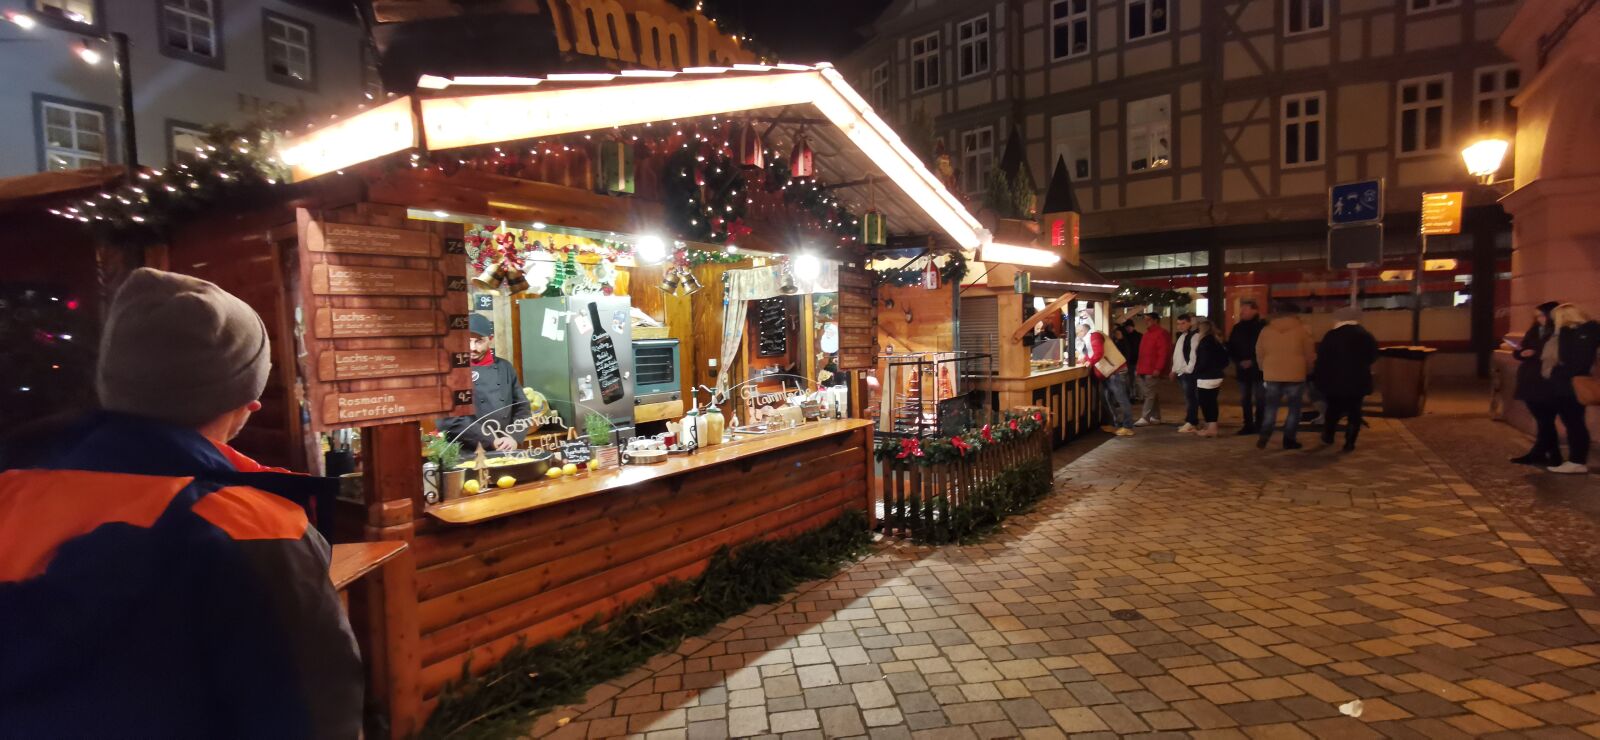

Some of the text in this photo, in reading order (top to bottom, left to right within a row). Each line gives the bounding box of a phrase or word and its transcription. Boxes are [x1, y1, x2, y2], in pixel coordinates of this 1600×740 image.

[336, 353, 396, 364] Lachs-Wrap
[338, 393, 395, 407] Rosmarin
[339, 404, 406, 419] Kartoffeln
